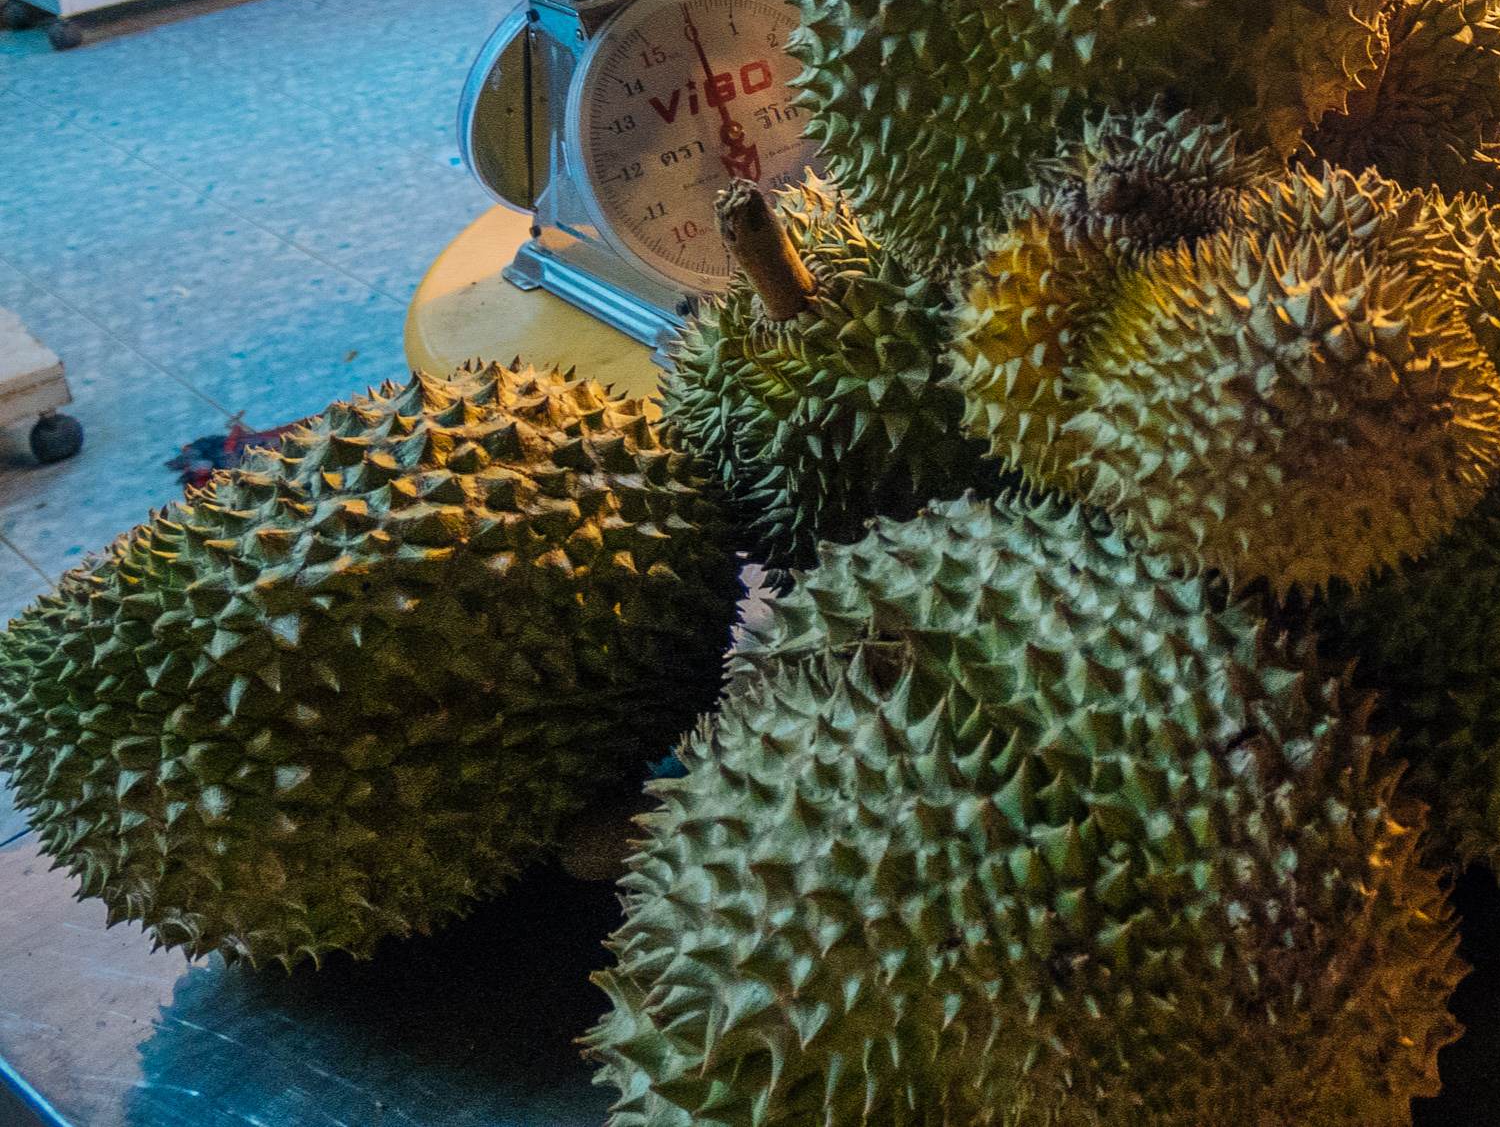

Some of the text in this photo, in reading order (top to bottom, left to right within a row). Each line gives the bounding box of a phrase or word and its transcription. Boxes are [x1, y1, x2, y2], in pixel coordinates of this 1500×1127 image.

[766, 32, 779, 48] 2
[640, 46, 667, 69] 15
[623, 78, 646, 98] 14
[621, 162, 644, 181] 12
[672, 220, 698, 244] 10
